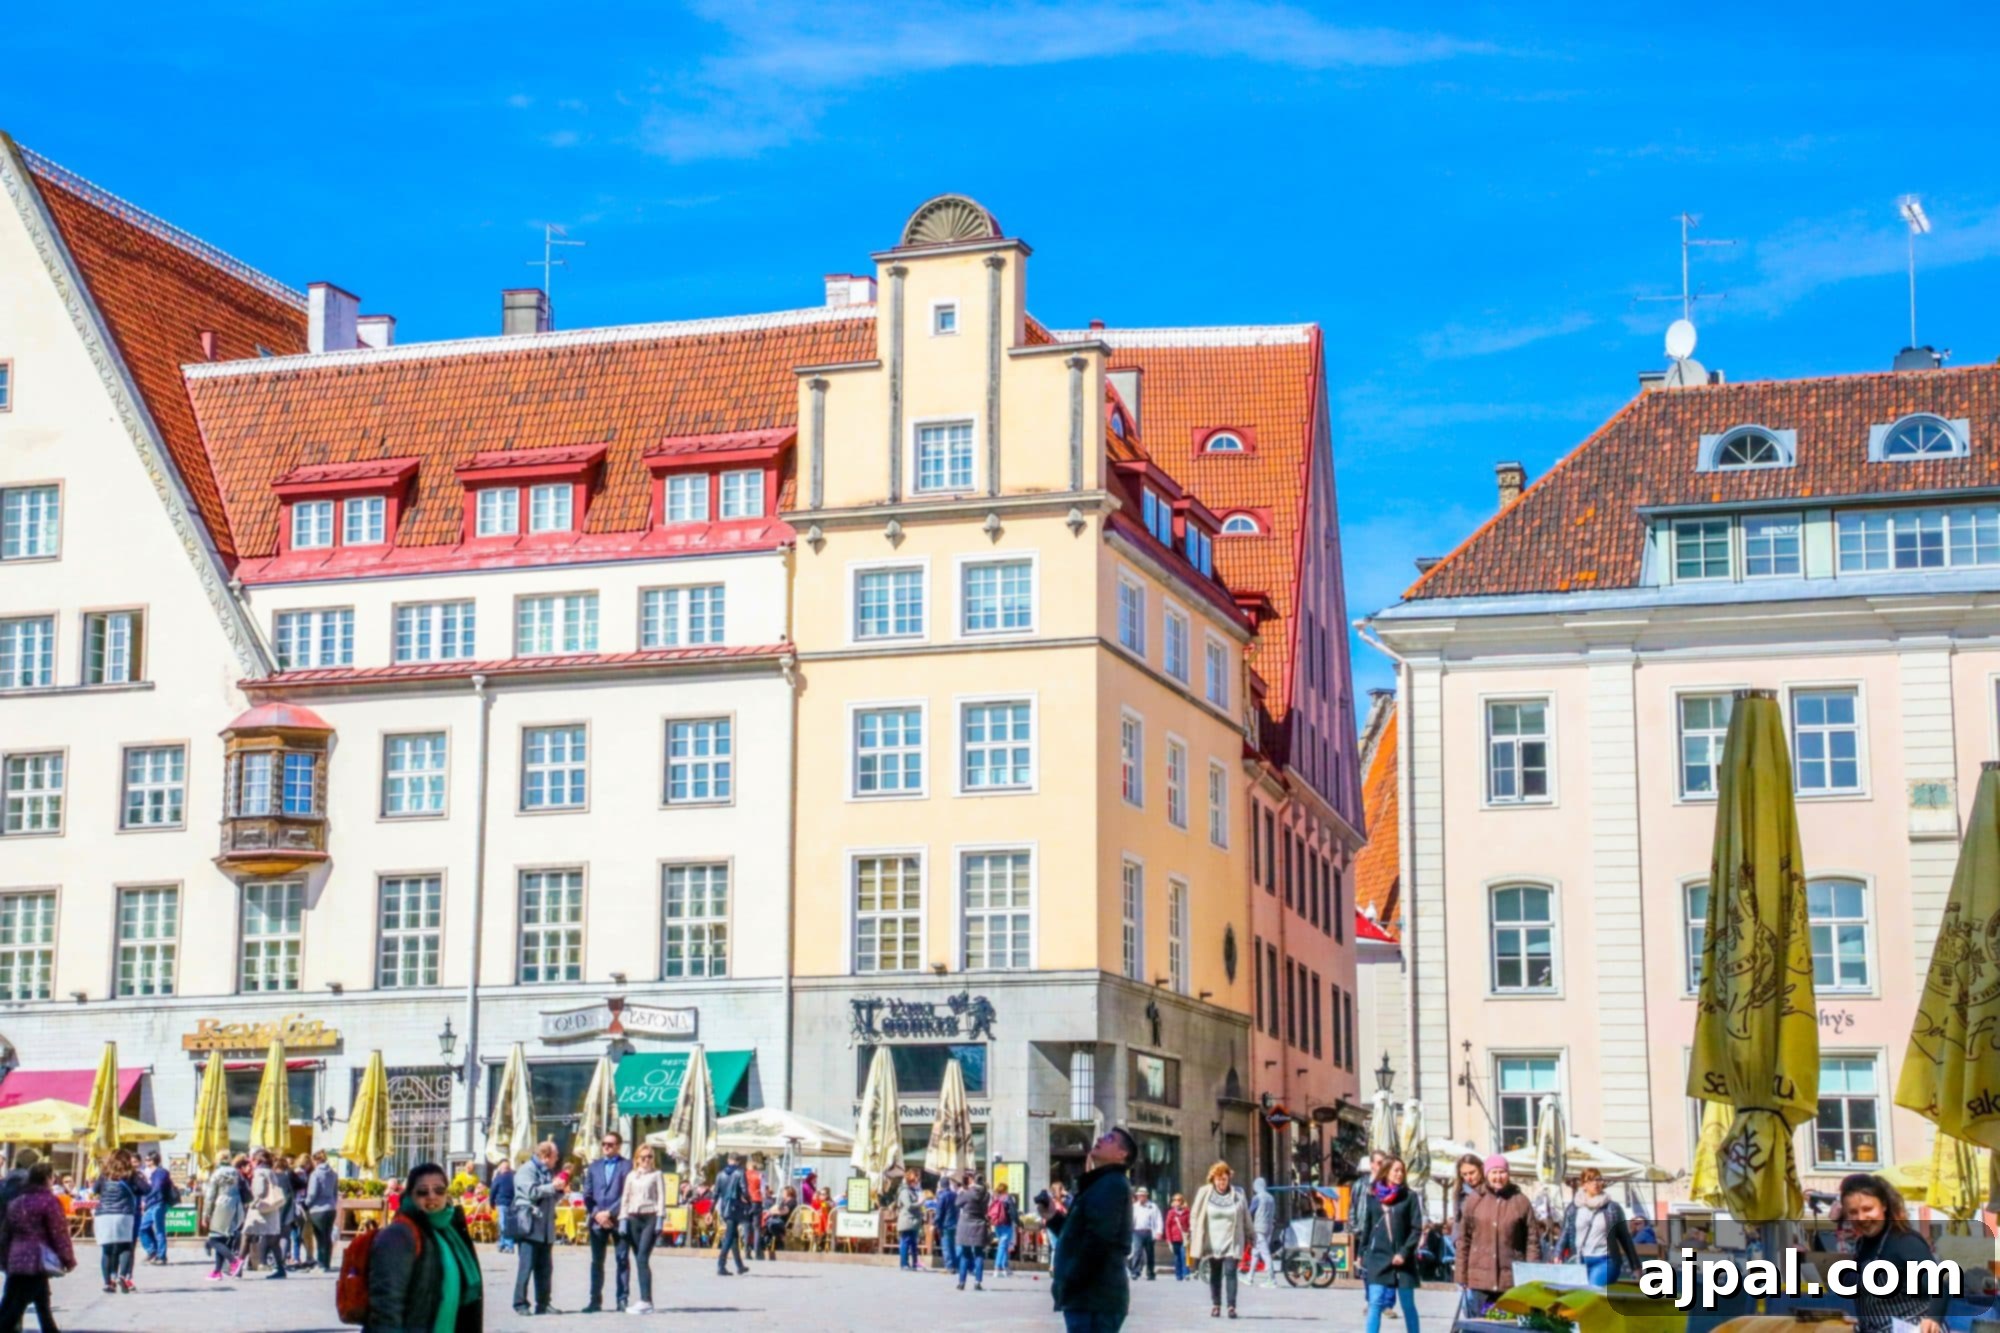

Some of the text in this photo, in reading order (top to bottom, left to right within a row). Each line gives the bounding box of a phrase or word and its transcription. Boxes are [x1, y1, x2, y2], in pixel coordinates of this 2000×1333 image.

[1818, 1008, 1855, 1035] hy's
[618, 1085, 682, 1103] ESTO
[1967, 1087, 2000, 1120] sak
[900, 1104, 937, 1117] Restor
